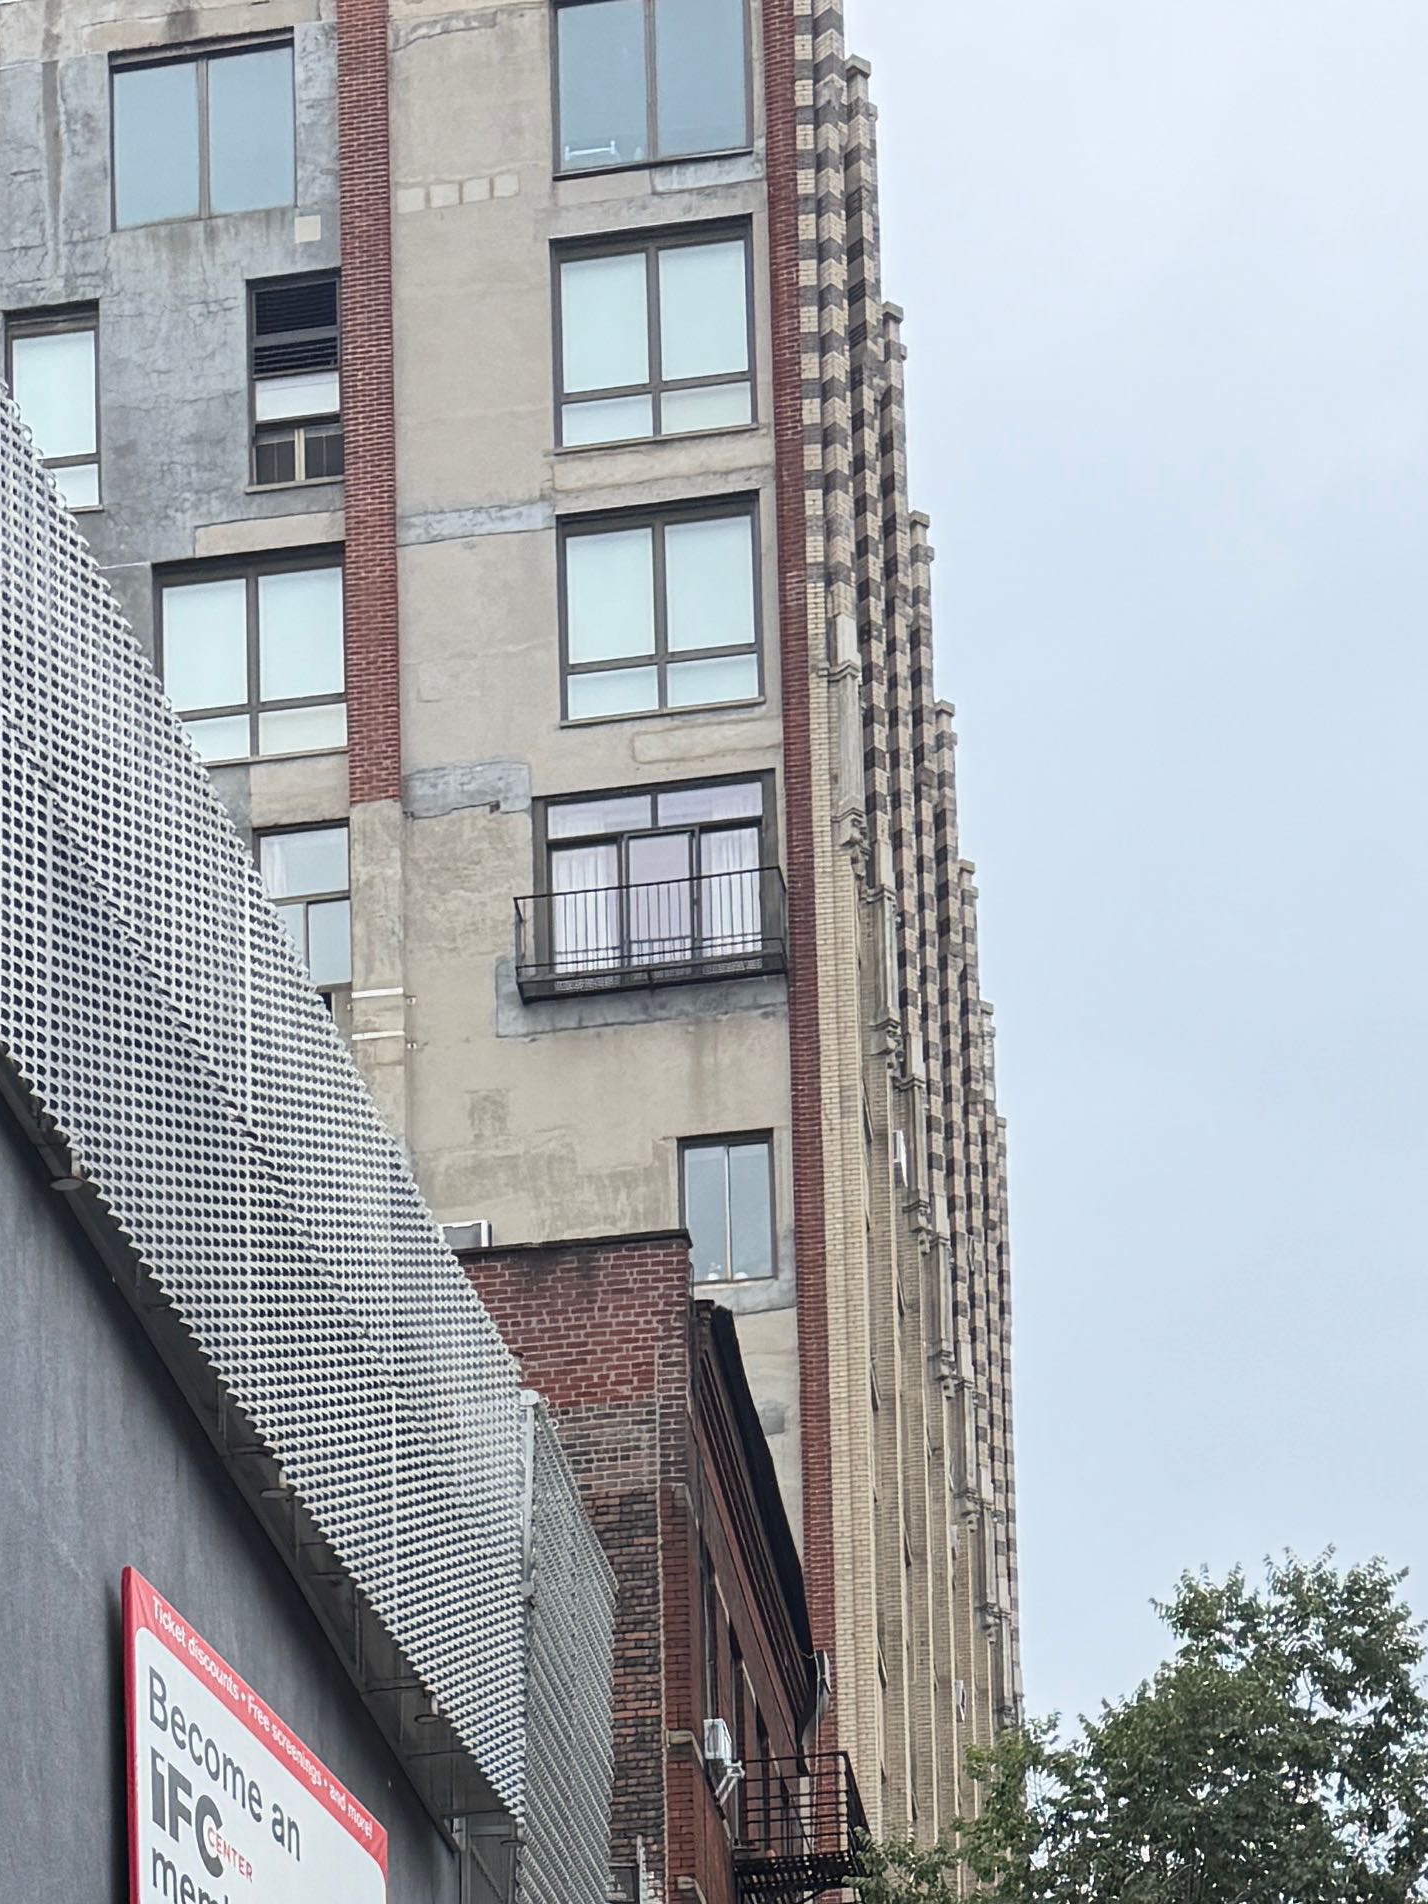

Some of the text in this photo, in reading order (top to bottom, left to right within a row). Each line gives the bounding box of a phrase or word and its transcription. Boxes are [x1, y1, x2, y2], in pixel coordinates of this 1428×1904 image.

[149, 1665, 301, 1862] Become an
[151, 1595, 373, 1840] Ticket discounts Free screenings and more!
[207, 1825, 253, 1883] CENTER
